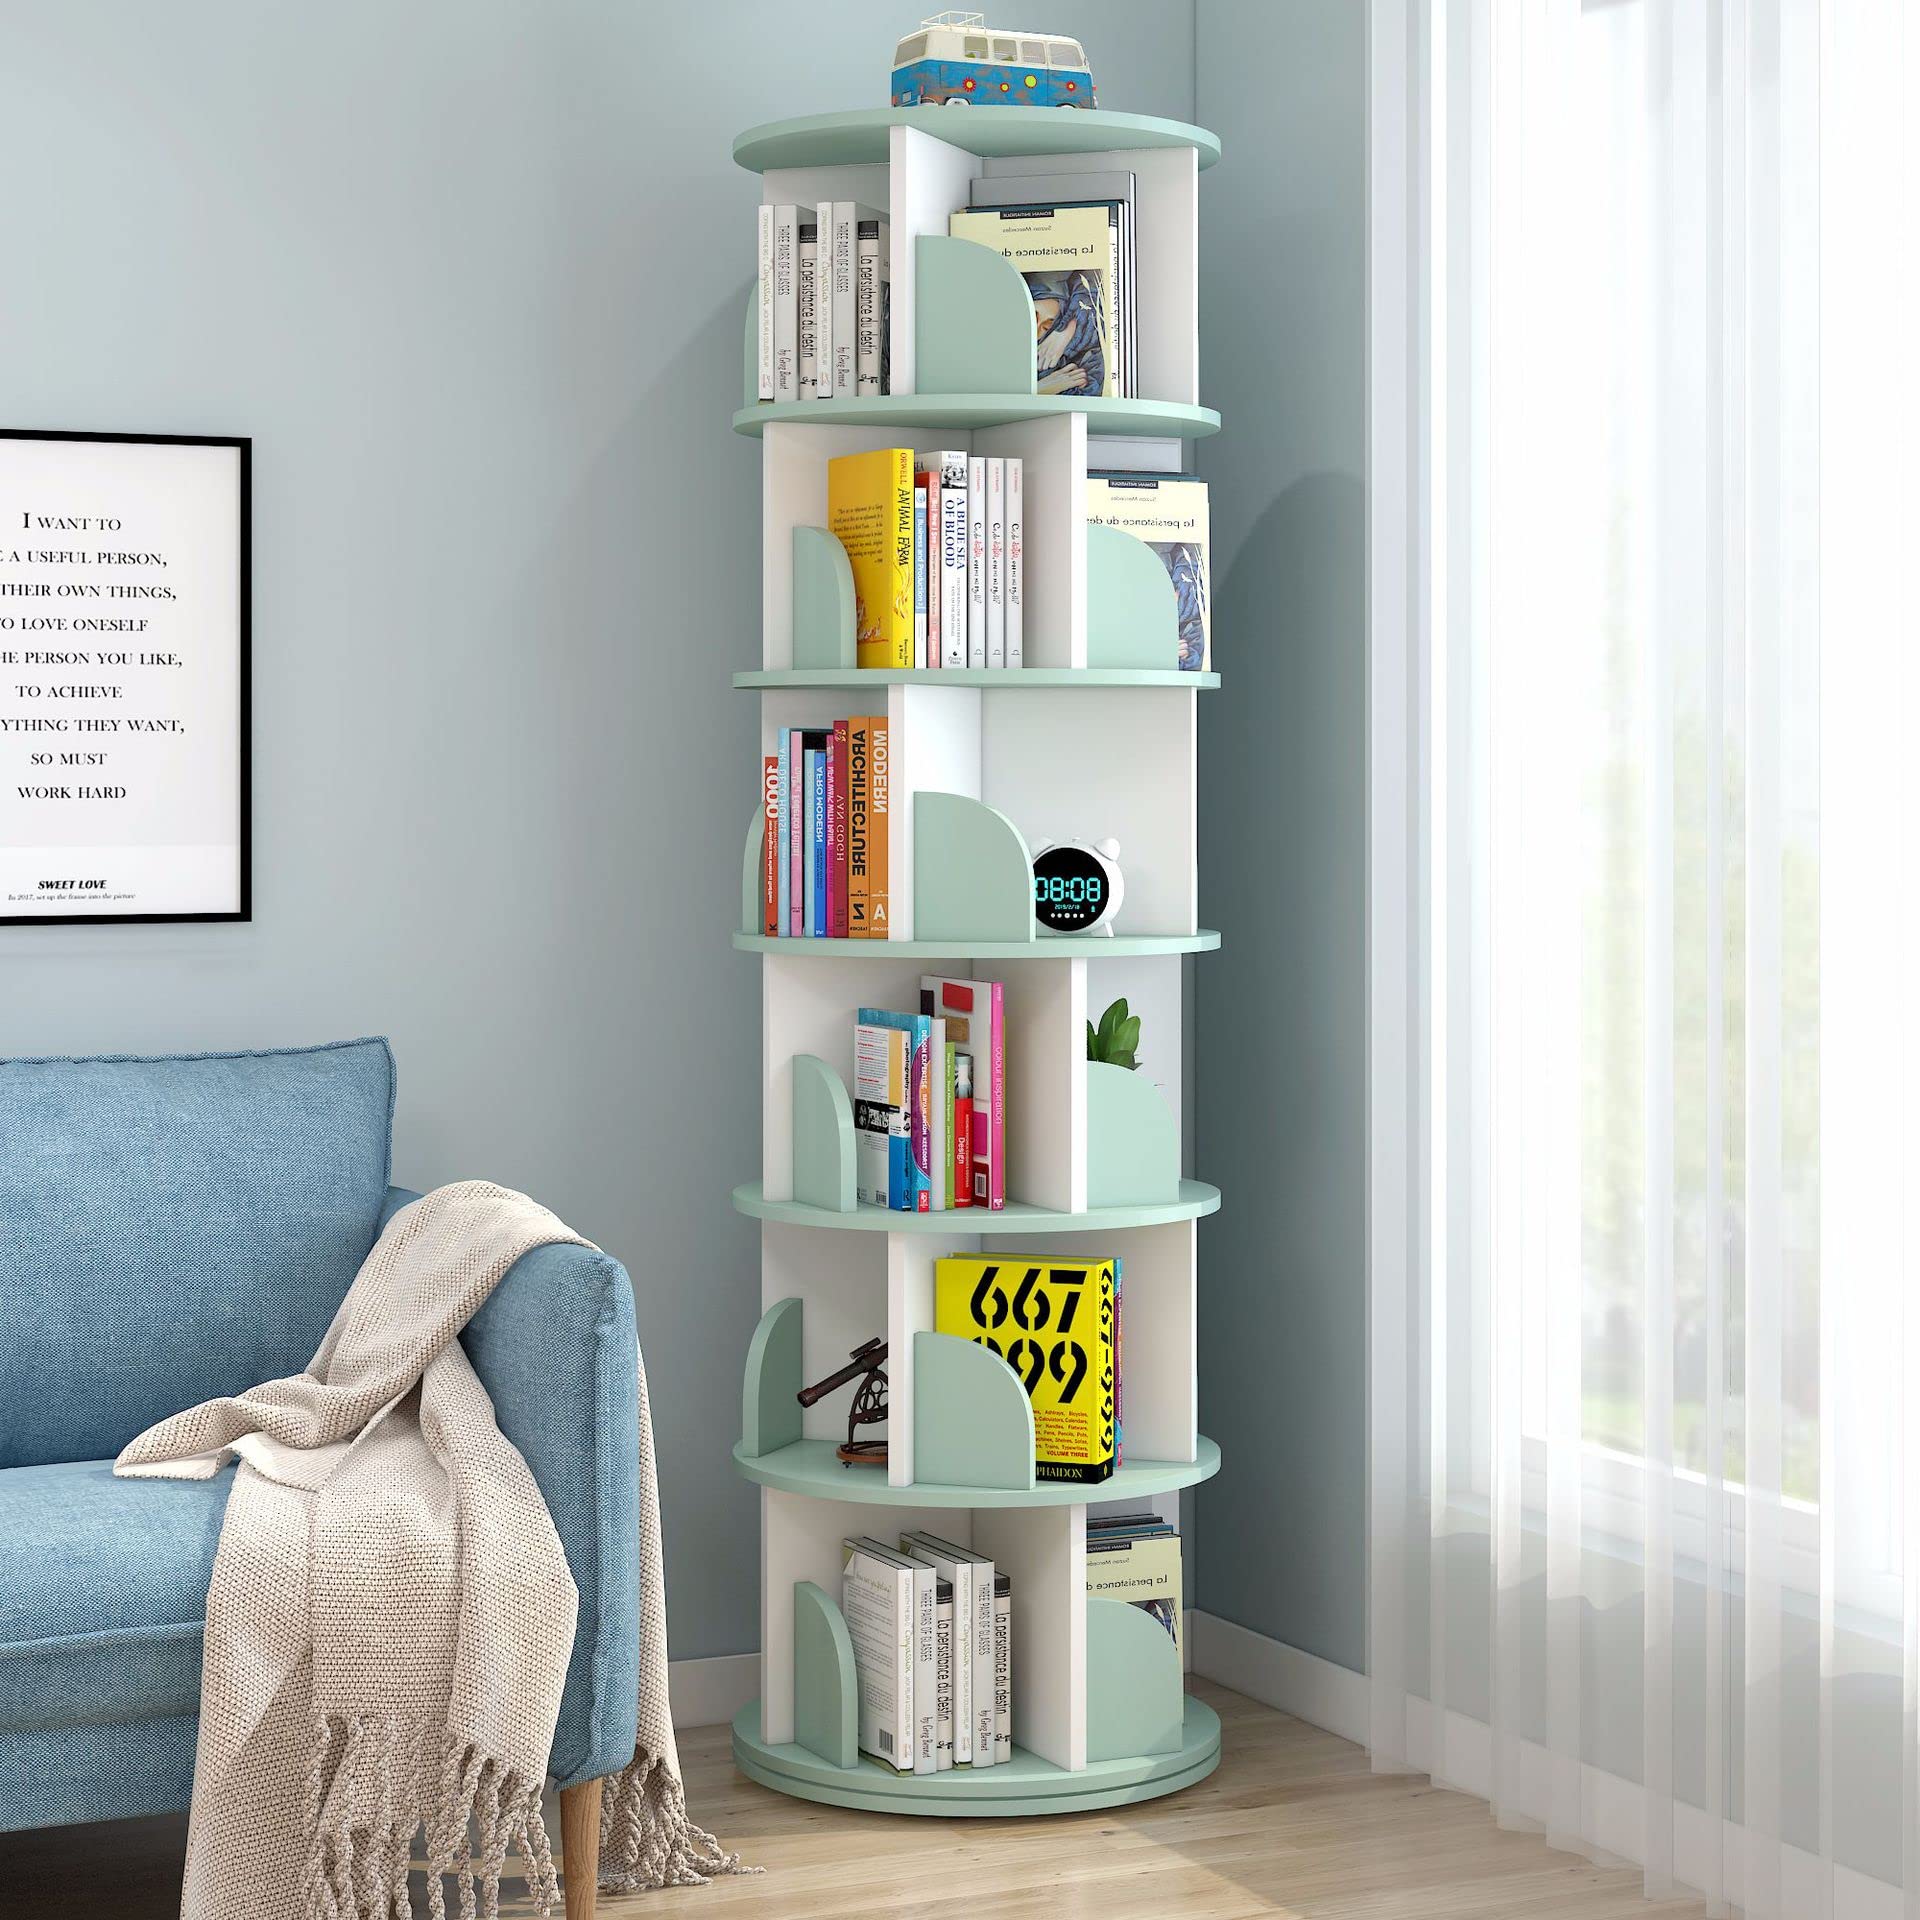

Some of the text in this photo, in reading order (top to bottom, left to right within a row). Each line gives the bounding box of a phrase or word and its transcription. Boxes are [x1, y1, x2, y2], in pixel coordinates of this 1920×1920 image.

[778, 225, 791, 243] THREE
[837, 222, 849, 240] THREE
[778, 245, 791, 260] PAIRS
[837, 241, 849, 257] PAIRS
[800, 258, 817, 268] La
[858, 255, 879, 265] La
[778, 271, 791, 296] GLASSES
[837, 268, 849, 293] GLASSES
[800, 270, 817, 318] persistance
[858, 267, 879, 314] persistance
[800, 320, 817, 331] du
[858, 317, 879, 328] du
[800, 333, 817, 358] destin
[858, 331, 879, 355] destin
[900, 453, 908, 485] ORWELL
[23, 512, 122, 531] I WANT TO
[897, 488, 911, 566] ANIMAL FARM
[945, 500, 955, 567] OF BLOOD
[957, 498, 966, 570] A BLUE SEA
[9, 550, 167, 568] A USEFUL PERSON,
[917, 519, 926, 601] Business and Production
[0, 583, 177, 601] THEIR OWN THINGS,
[0, 618, 148, 632] O LOVE ONESELF
[25, 652, 183, 668] PERSON YOU LIKE,
[15, 685, 123, 698] TO ACHIEVE
[0, 719, 185, 735] YTHING THEY WANT,
[30, 752, 107, 765] SO MUST
[18, 787, 127, 798] WORK HARD
[38, 880, 107, 890] SWEET LOVE
[1035, 877, 1101, 901] 08:08
[113, 893, 136, 901] picture
[994, 1047, 1005, 1124] colour inspiration
[956, 1137, 966, 1164] Design
[970, 1266, 1087, 1333] 667
[1100, 1267, 1113, 1453] 667-999
[1037, 1466, 1082, 1478] PHAIDON
[920, 1589, 932, 1607] THREE
[920, 1609, 932, 1625] PAIRS
[978, 1583, 990, 1656] THREE PAIRS OF GLASSES
[920, 1636, 932, 1662] GLASSES
[937, 1618, 952, 1722] La persistance du destin
[995, 1613, 1010, 1715] La persistance du destin
